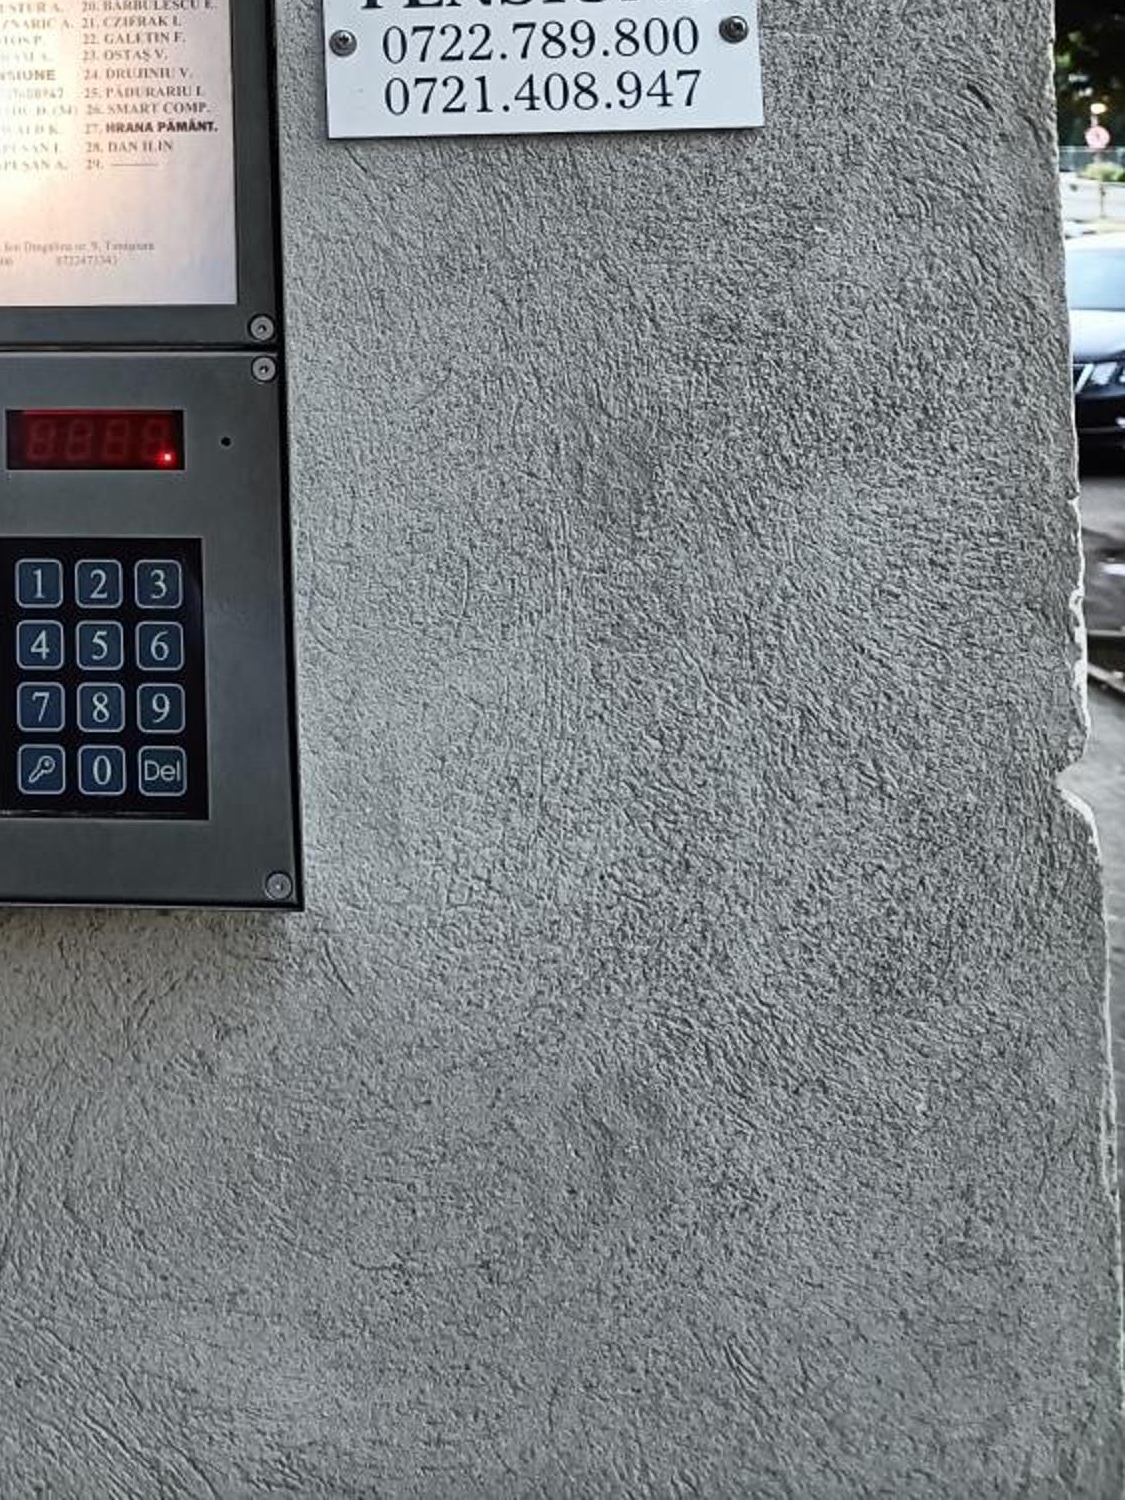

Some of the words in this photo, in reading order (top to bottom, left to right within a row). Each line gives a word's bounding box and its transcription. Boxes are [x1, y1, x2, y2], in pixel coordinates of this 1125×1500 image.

[82, 17, 100, 29] 21.
[382, 16, 699, 64] 0722.789.800
[384, 69, 702, 116] 0721.408.947
[108, 103, 157, 115] SMART
[163, 103, 211, 114] COMP.
[106, 122, 154, 133] HRANA
[108, 141, 138, 153] DAN
[33, 570, 46, 599] 1
[90, 569, 108, 599] 2
[151, 570, 167, 599] 3
[31, 631, 50, 660] 4
[92, 631, 108, 661] 5
[151, 632, 169, 660] 6
[32, 692, 50, 723] 7
[92, 692, 110, 723] 8
[152, 693, 170, 723] 9
[93, 756, 112, 785] 0
[144, 761, 181, 782] Del
